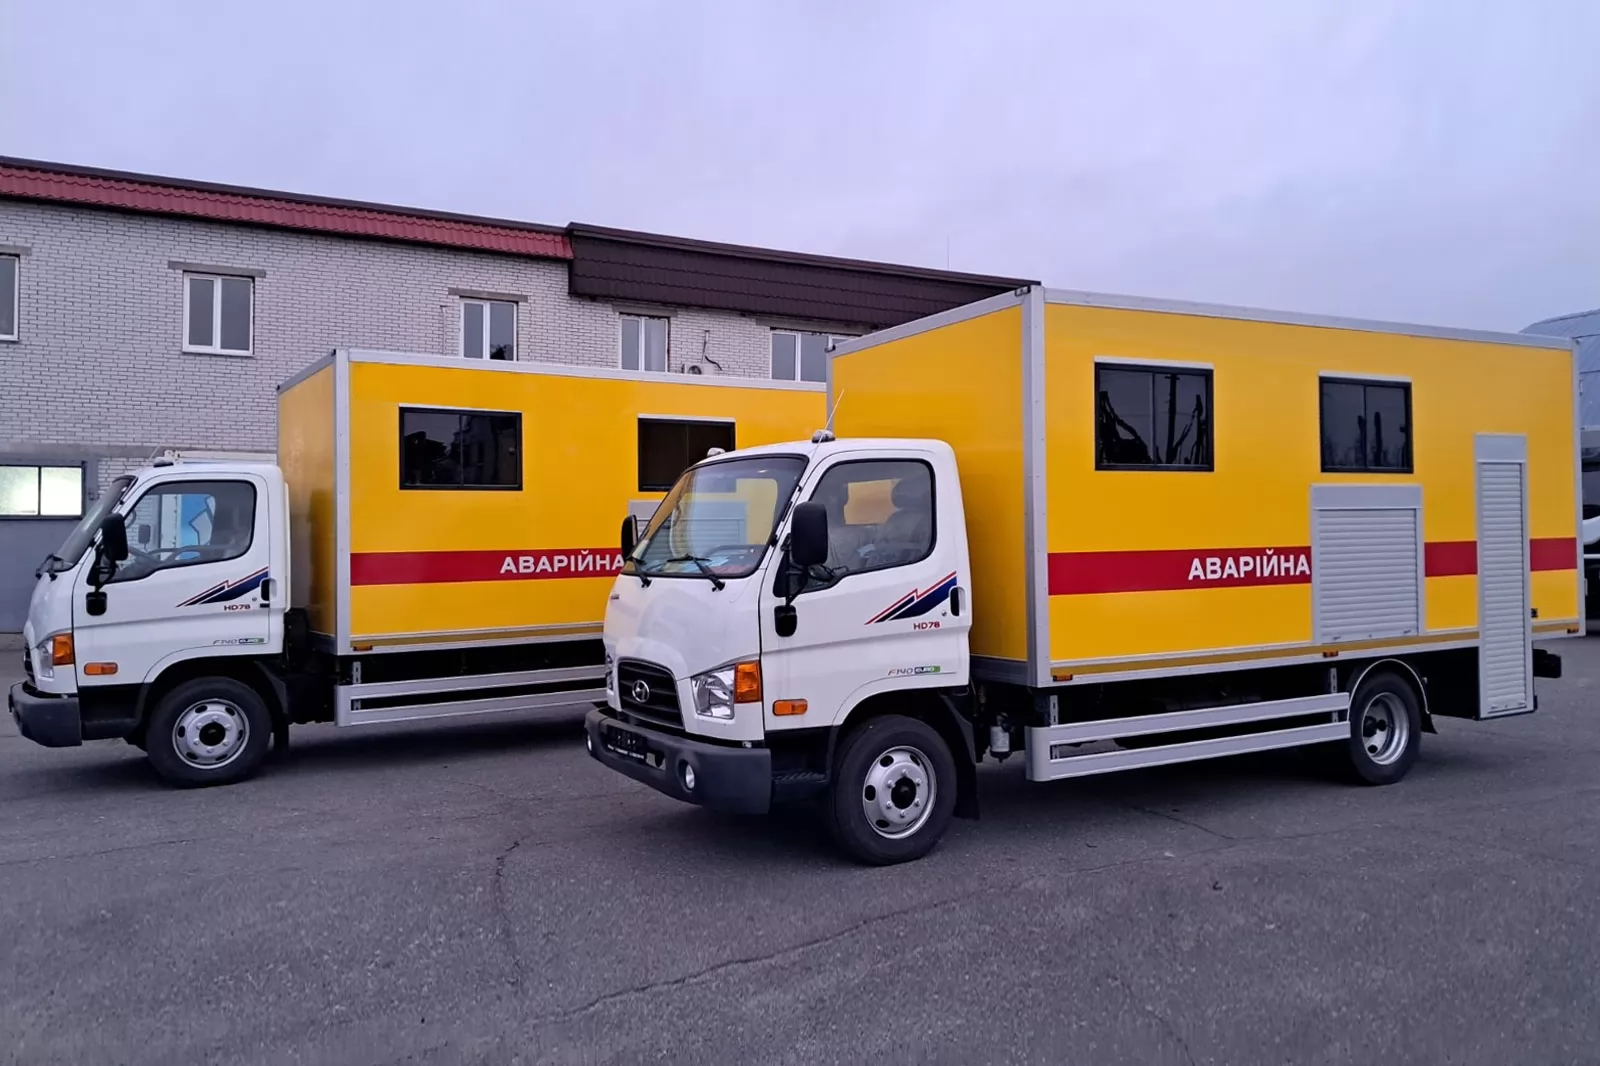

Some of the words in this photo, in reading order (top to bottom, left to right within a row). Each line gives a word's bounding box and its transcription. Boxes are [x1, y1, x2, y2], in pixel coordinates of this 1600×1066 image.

[500, 549, 625, 574] АВАРІЙНА
[1187, 548, 1311, 580] АВАРІЙНА
[223, 603, 251, 611] HD78
[913, 621, 941, 630] HD78
